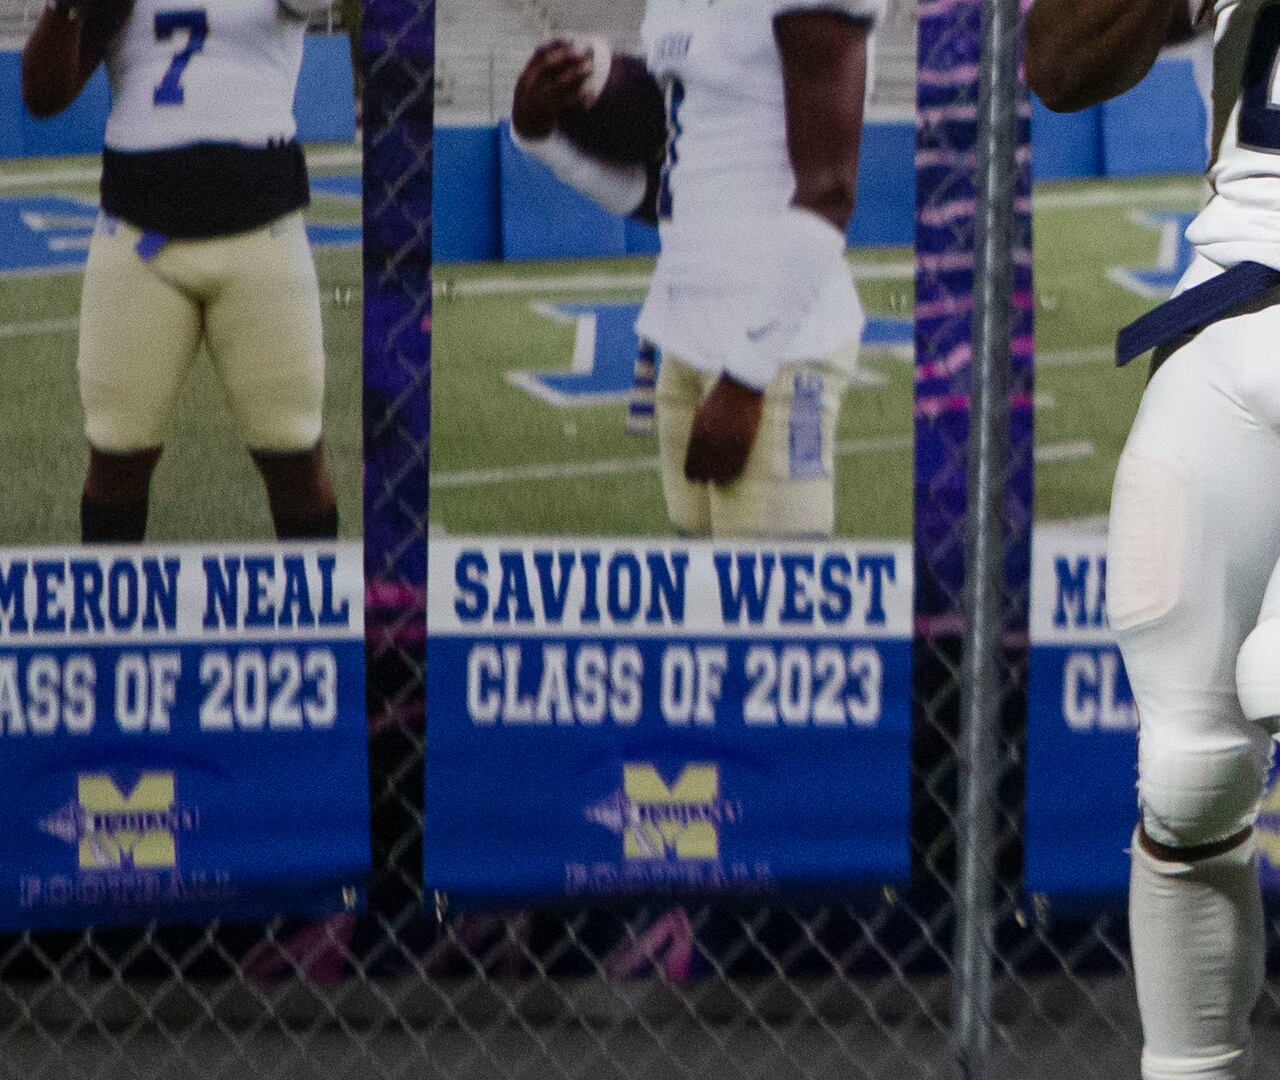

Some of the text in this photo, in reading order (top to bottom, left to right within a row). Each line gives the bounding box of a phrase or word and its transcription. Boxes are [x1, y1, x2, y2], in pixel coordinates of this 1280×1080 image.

[153, 10, 208, 105] 7
[202, 554, 350, 626] NEAL
[453, 552, 897, 626] SAVION WEST
[114, 652, 182, 735] OF
[199, 648, 338, 731] 2023
[467, 645, 883, 728] CLASS OF 2023
